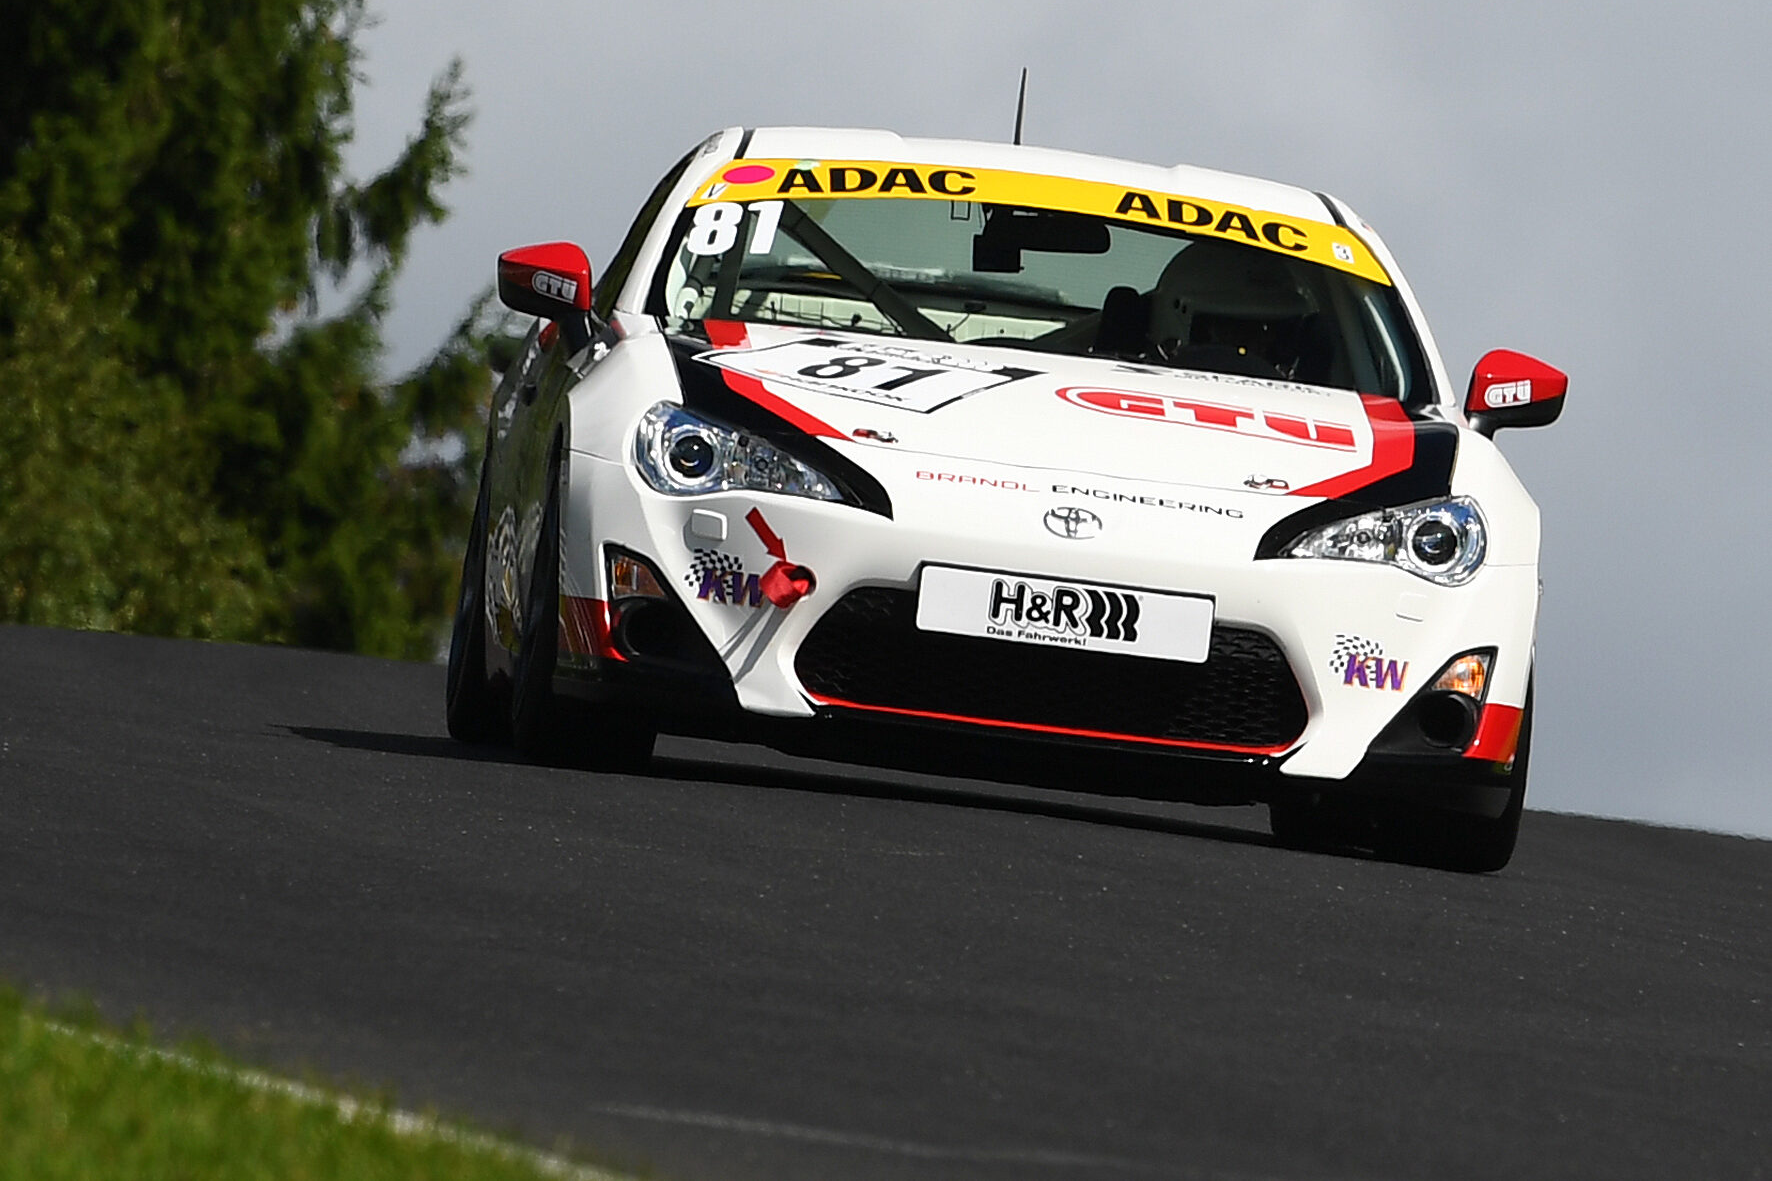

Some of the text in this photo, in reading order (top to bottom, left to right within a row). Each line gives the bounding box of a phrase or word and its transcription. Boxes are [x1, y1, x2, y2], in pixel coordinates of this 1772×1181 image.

[777, 167, 976, 195] ADAC
[686, 201, 785, 256] 81
[1114, 191, 1309, 252] ADAC
[797, 356, 951, 391] 81
[915, 470, 1245, 520] BRANDL ENGINEERING
[697, 568, 766, 608] KW
[989, 579, 1084, 629] H&R
[986, 626, 1014, 637] Das
[1343, 653, 1409, 692] KW
